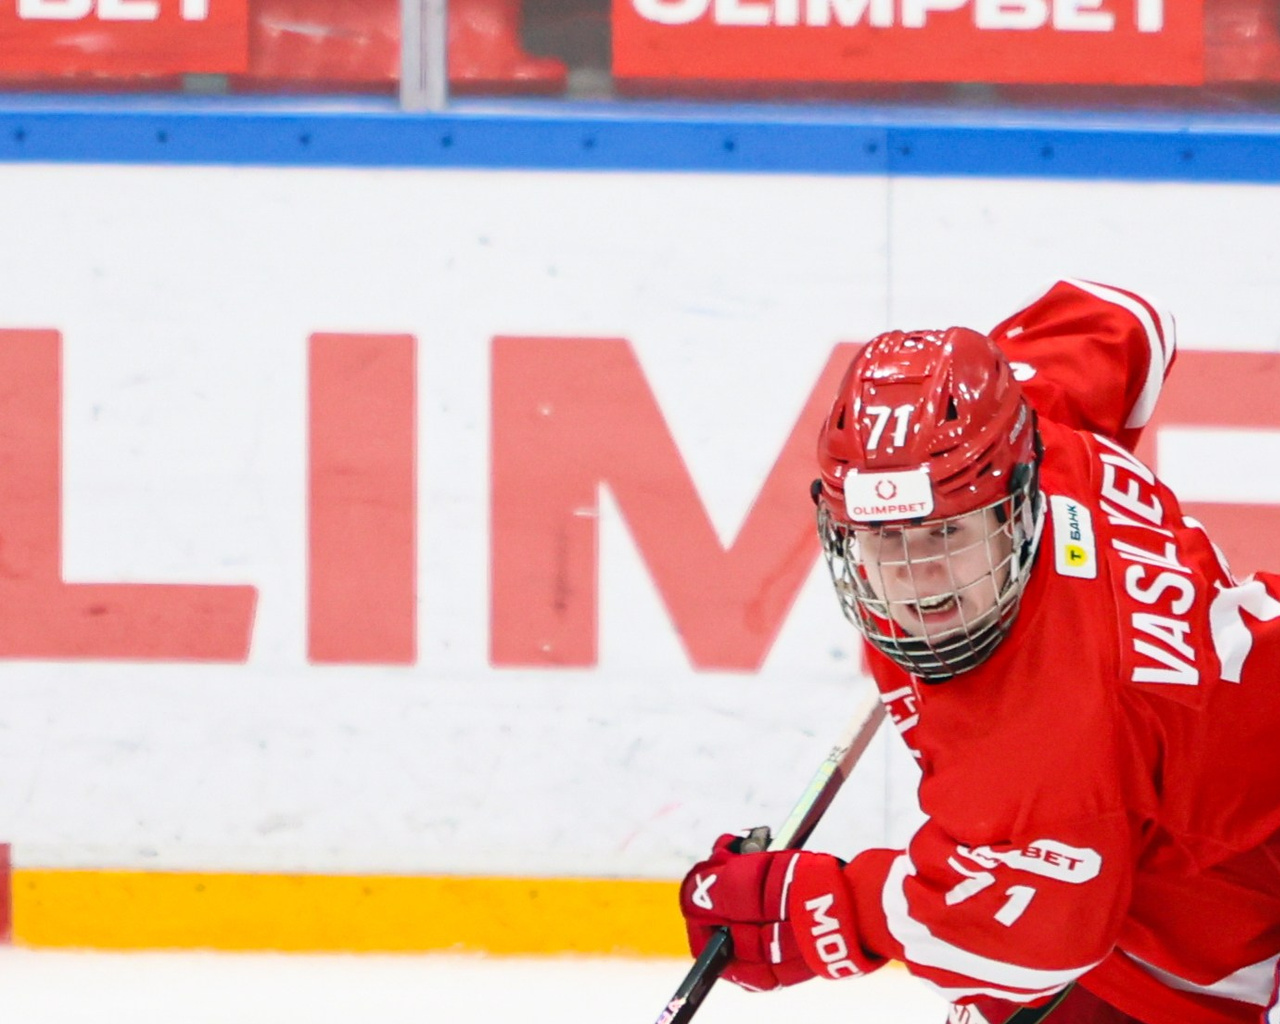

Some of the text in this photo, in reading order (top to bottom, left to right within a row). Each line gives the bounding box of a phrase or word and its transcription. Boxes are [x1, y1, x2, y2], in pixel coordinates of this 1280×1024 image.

[865, 404, 914, 450] 71
[853, 502, 926, 515] OLIMPBET
[1066, 503, 1082, 542] БАНК
[944, 856, 1037, 928] 71
